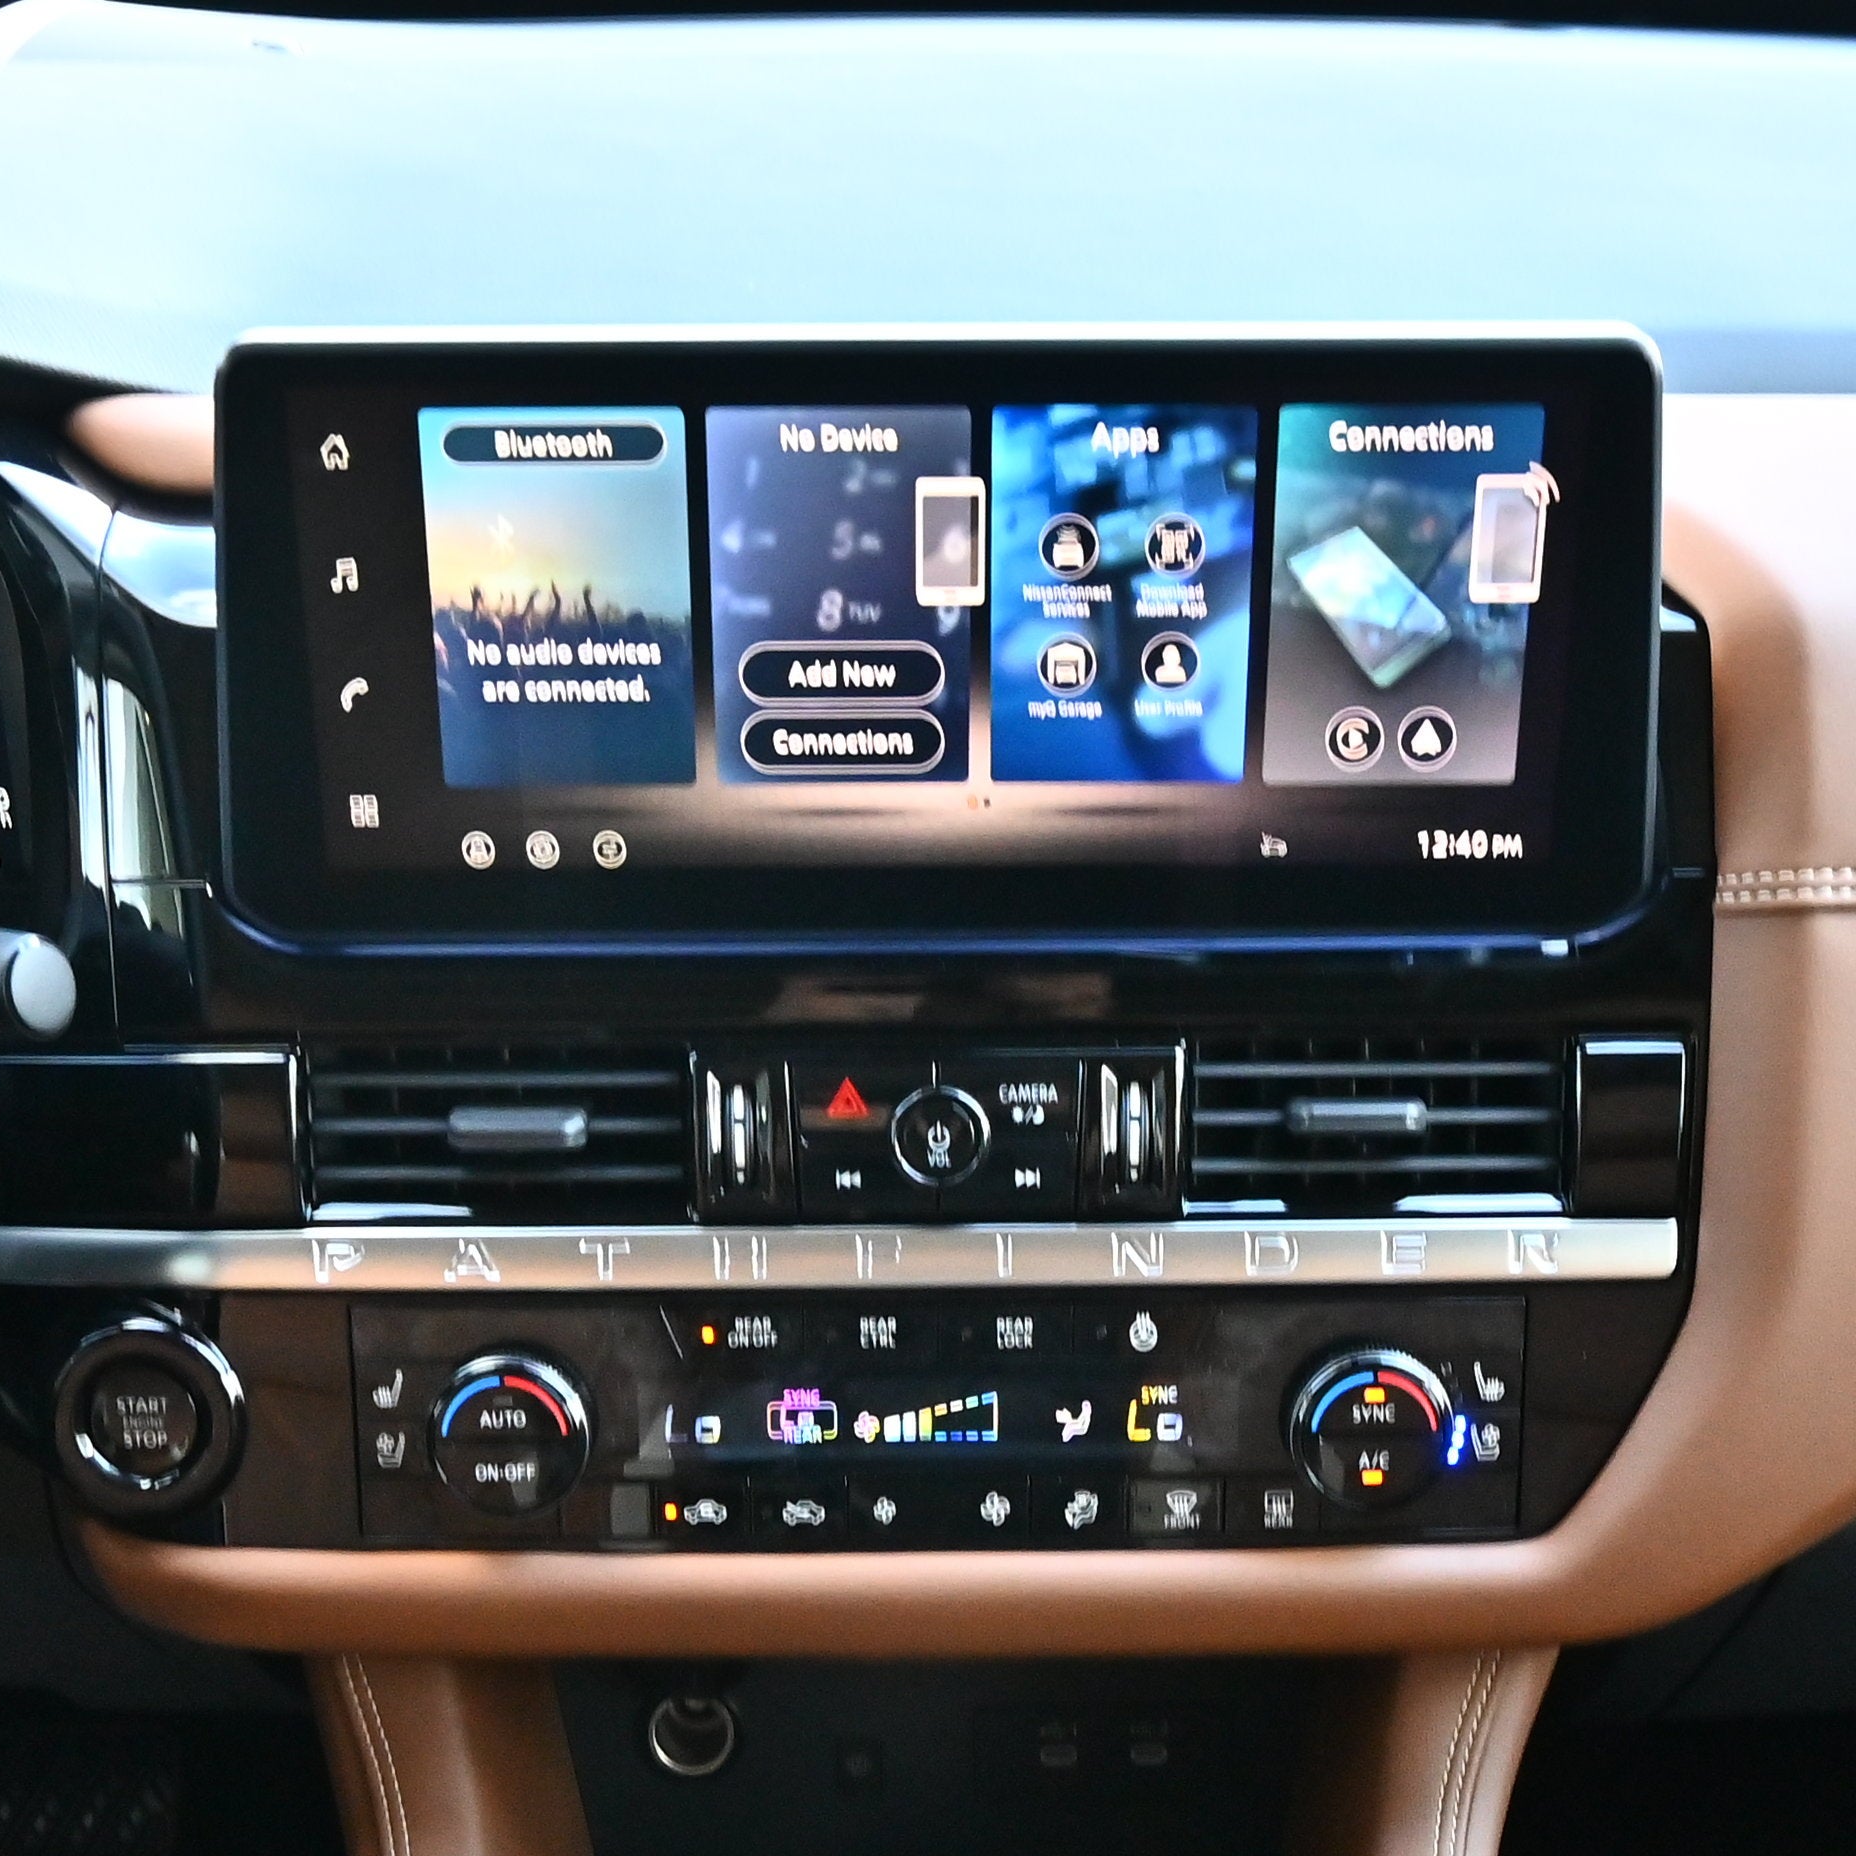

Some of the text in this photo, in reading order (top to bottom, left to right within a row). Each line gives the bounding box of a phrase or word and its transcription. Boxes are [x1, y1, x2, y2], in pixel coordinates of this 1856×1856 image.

[494, 430, 613, 459] Bluetooth
[779, 423, 899, 453] No Device
[1091, 422, 1160, 457] Apps
[1328, 421, 1495, 453] Connections
[467, 638, 662, 667] No audio devices
[788, 660, 897, 689] Add New
[482, 675, 651, 703] are connected.
[1058, 701, 1103, 720] Garage
[772, 728, 915, 756] Connections
[1417, 829, 1523, 860] 12:40 PM
[998, 1082, 1059, 1104] CAMERA
[927, 1149, 953, 1169] VOL
[311, 1231, 1560, 1284] PATHFINDER
[734, 1316, 772, 1333] REAR
[859, 1316, 897, 1333] REAR
[996, 1316, 1034, 1333] REAR
[996, 1332, 1034, 1350] LOCK
[116, 1396, 167, 1415] START
[782, 1388, 821, 1408] SYNC
[1141, 1384, 1179, 1406] SYNC
[122, 1416, 165, 1431] ENGINE
[479, 1409, 527, 1431] AUTO
[1352, 1402, 1396, 1424] SYNC
[123, 1430, 168, 1450] STOP
[783, 1424, 823, 1444] REAR
[1358, 1449, 1390, 1471] A/C
[1163, 1512, 1201, 1531] FRONT
